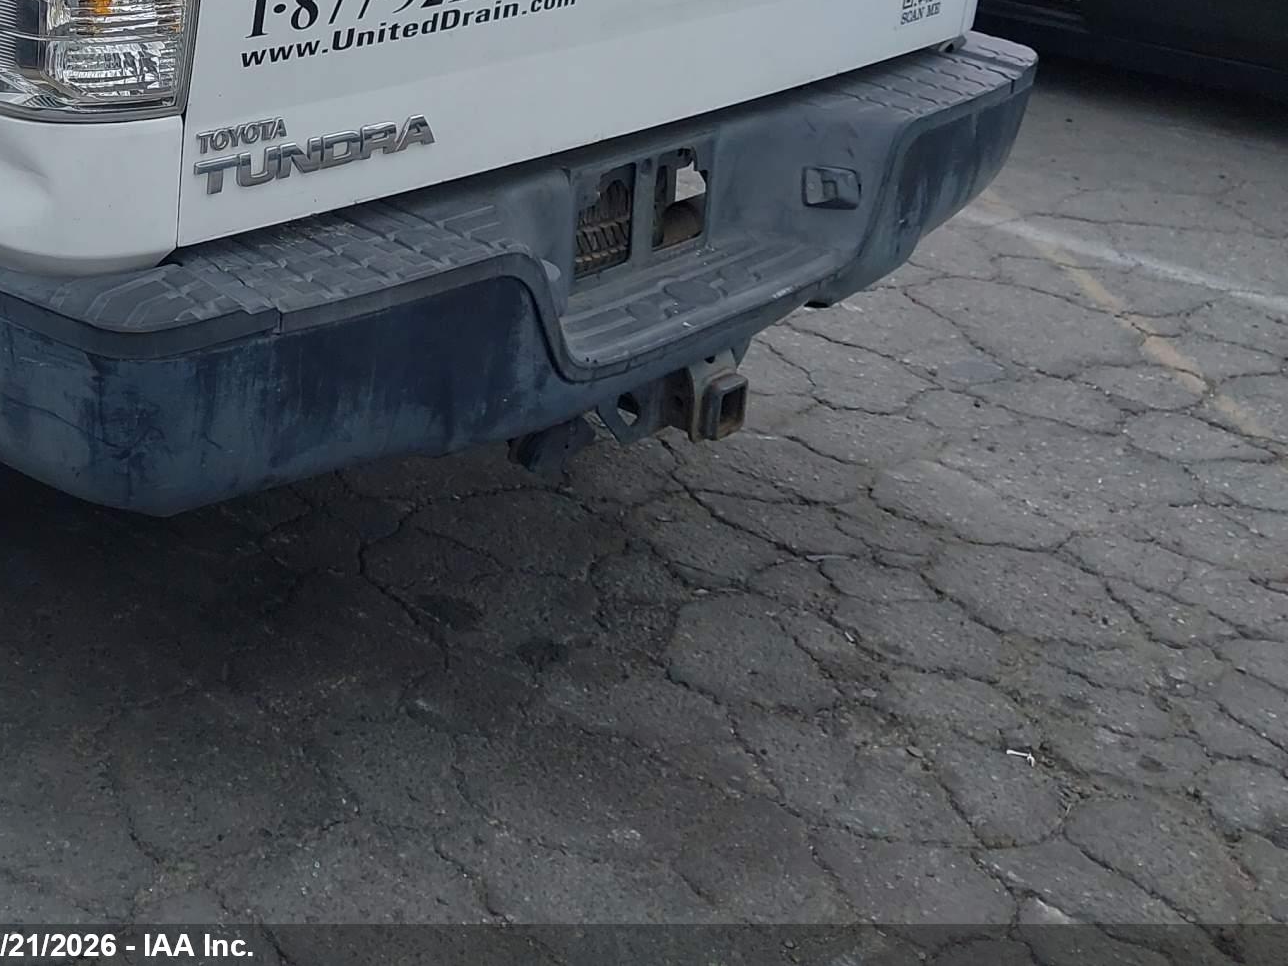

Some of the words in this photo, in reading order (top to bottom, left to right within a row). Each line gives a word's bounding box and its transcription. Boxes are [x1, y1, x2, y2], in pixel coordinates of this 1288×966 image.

[900, 6, 925, 25] SCAN
[926, 2, 941, 17] ME
[193, 113, 436, 195] TUNDRA
[197, 115, 288, 155] TOYOTA
